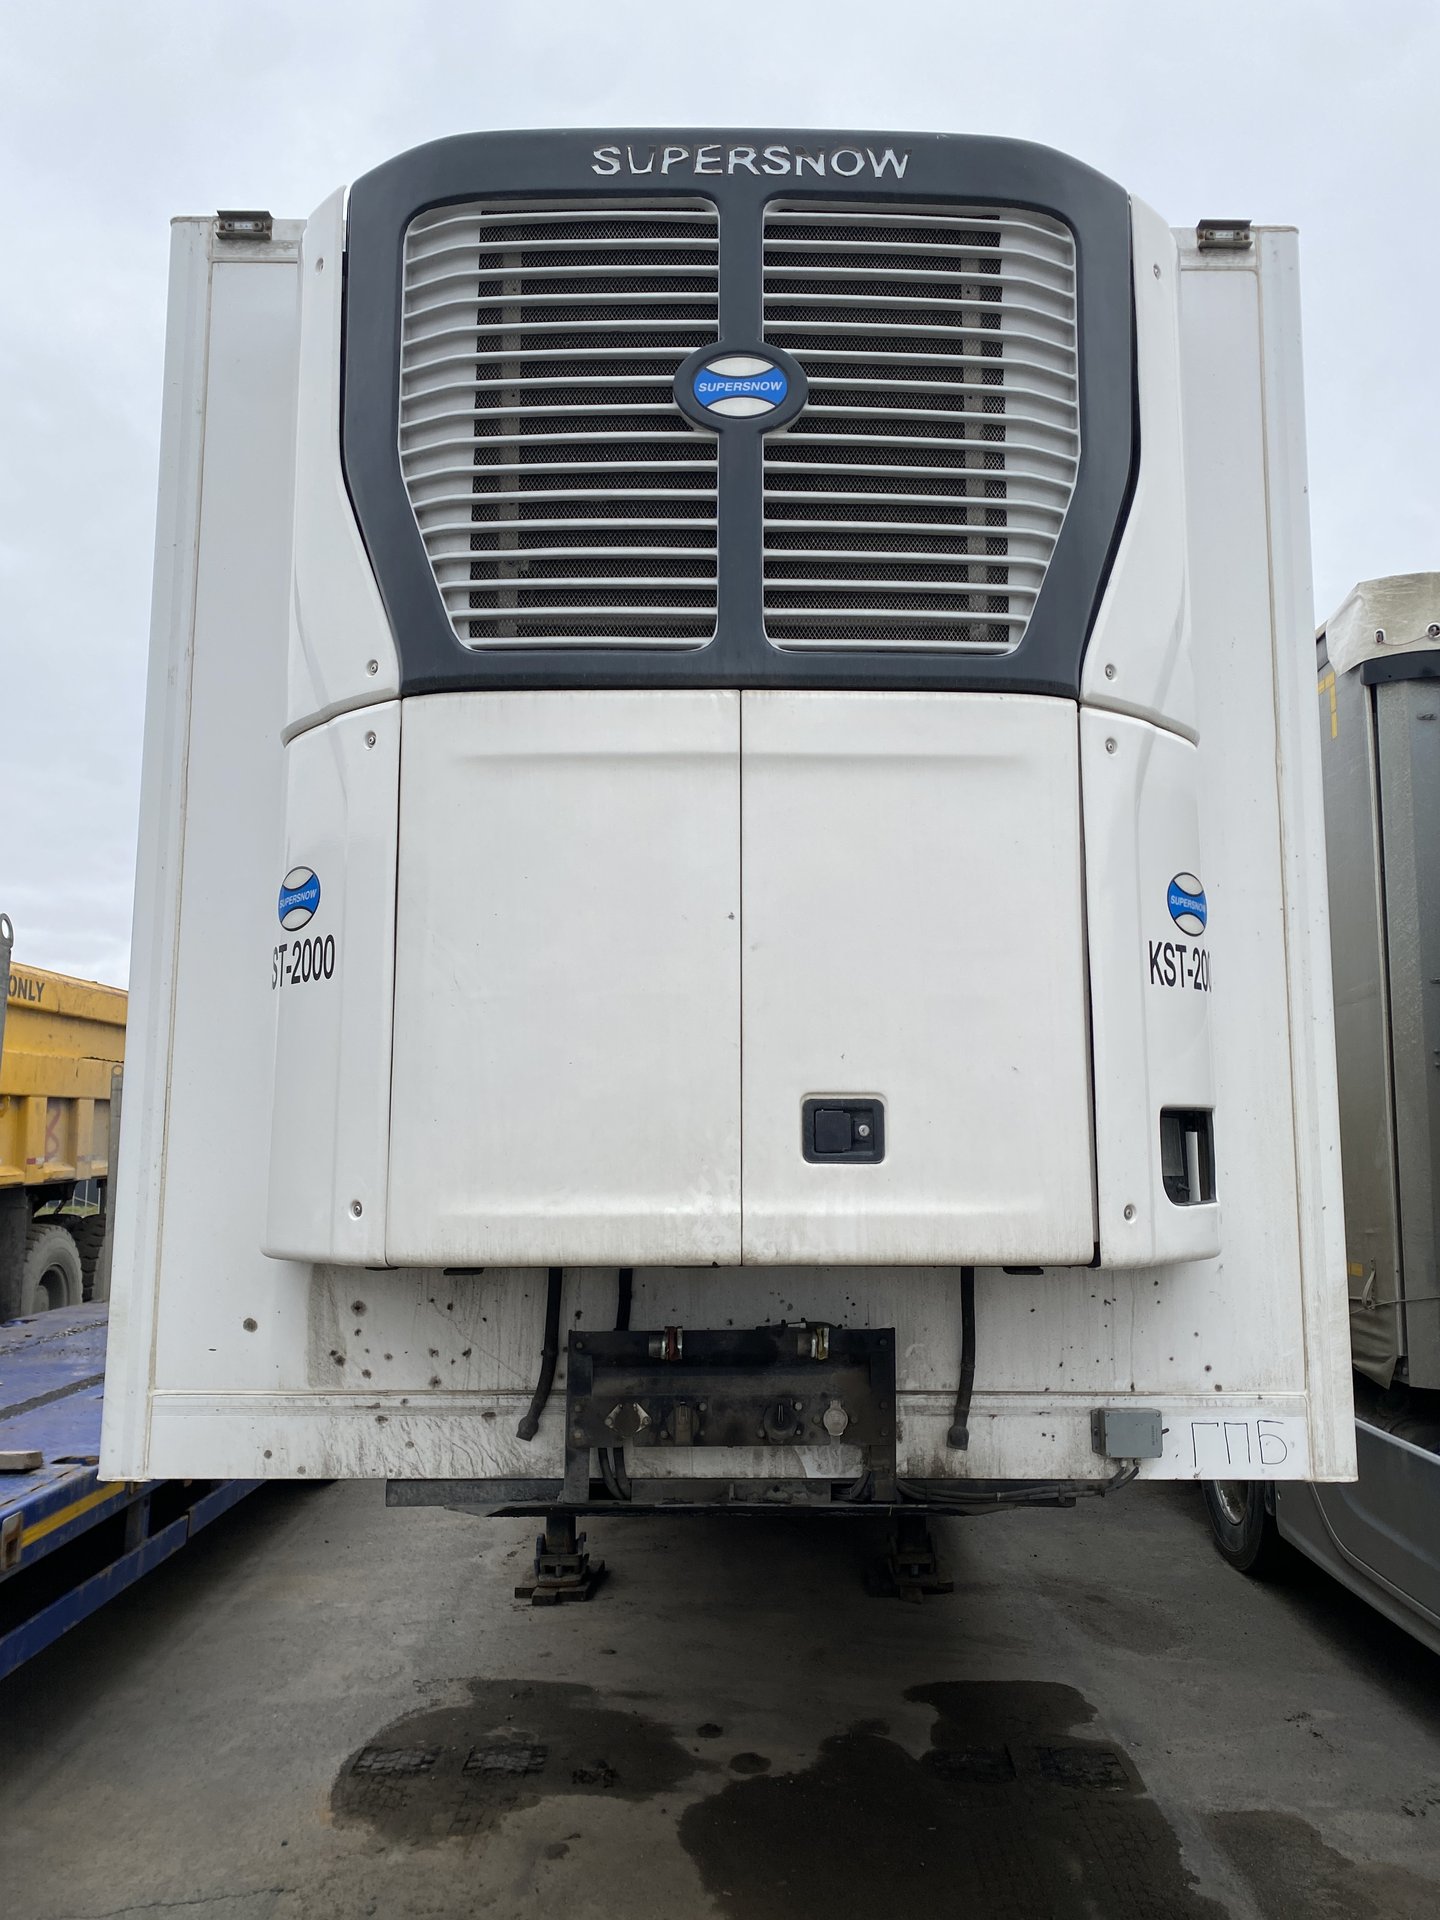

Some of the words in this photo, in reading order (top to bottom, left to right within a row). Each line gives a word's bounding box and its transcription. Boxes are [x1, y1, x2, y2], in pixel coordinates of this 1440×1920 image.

[591, 144, 908, 178] SUPERSNOW
[698, 381, 783, 392] SUPERSNOW
[8, 975, 45, 1002] ONLY
[1191, 1419, 1288, 1467] ГПБ
